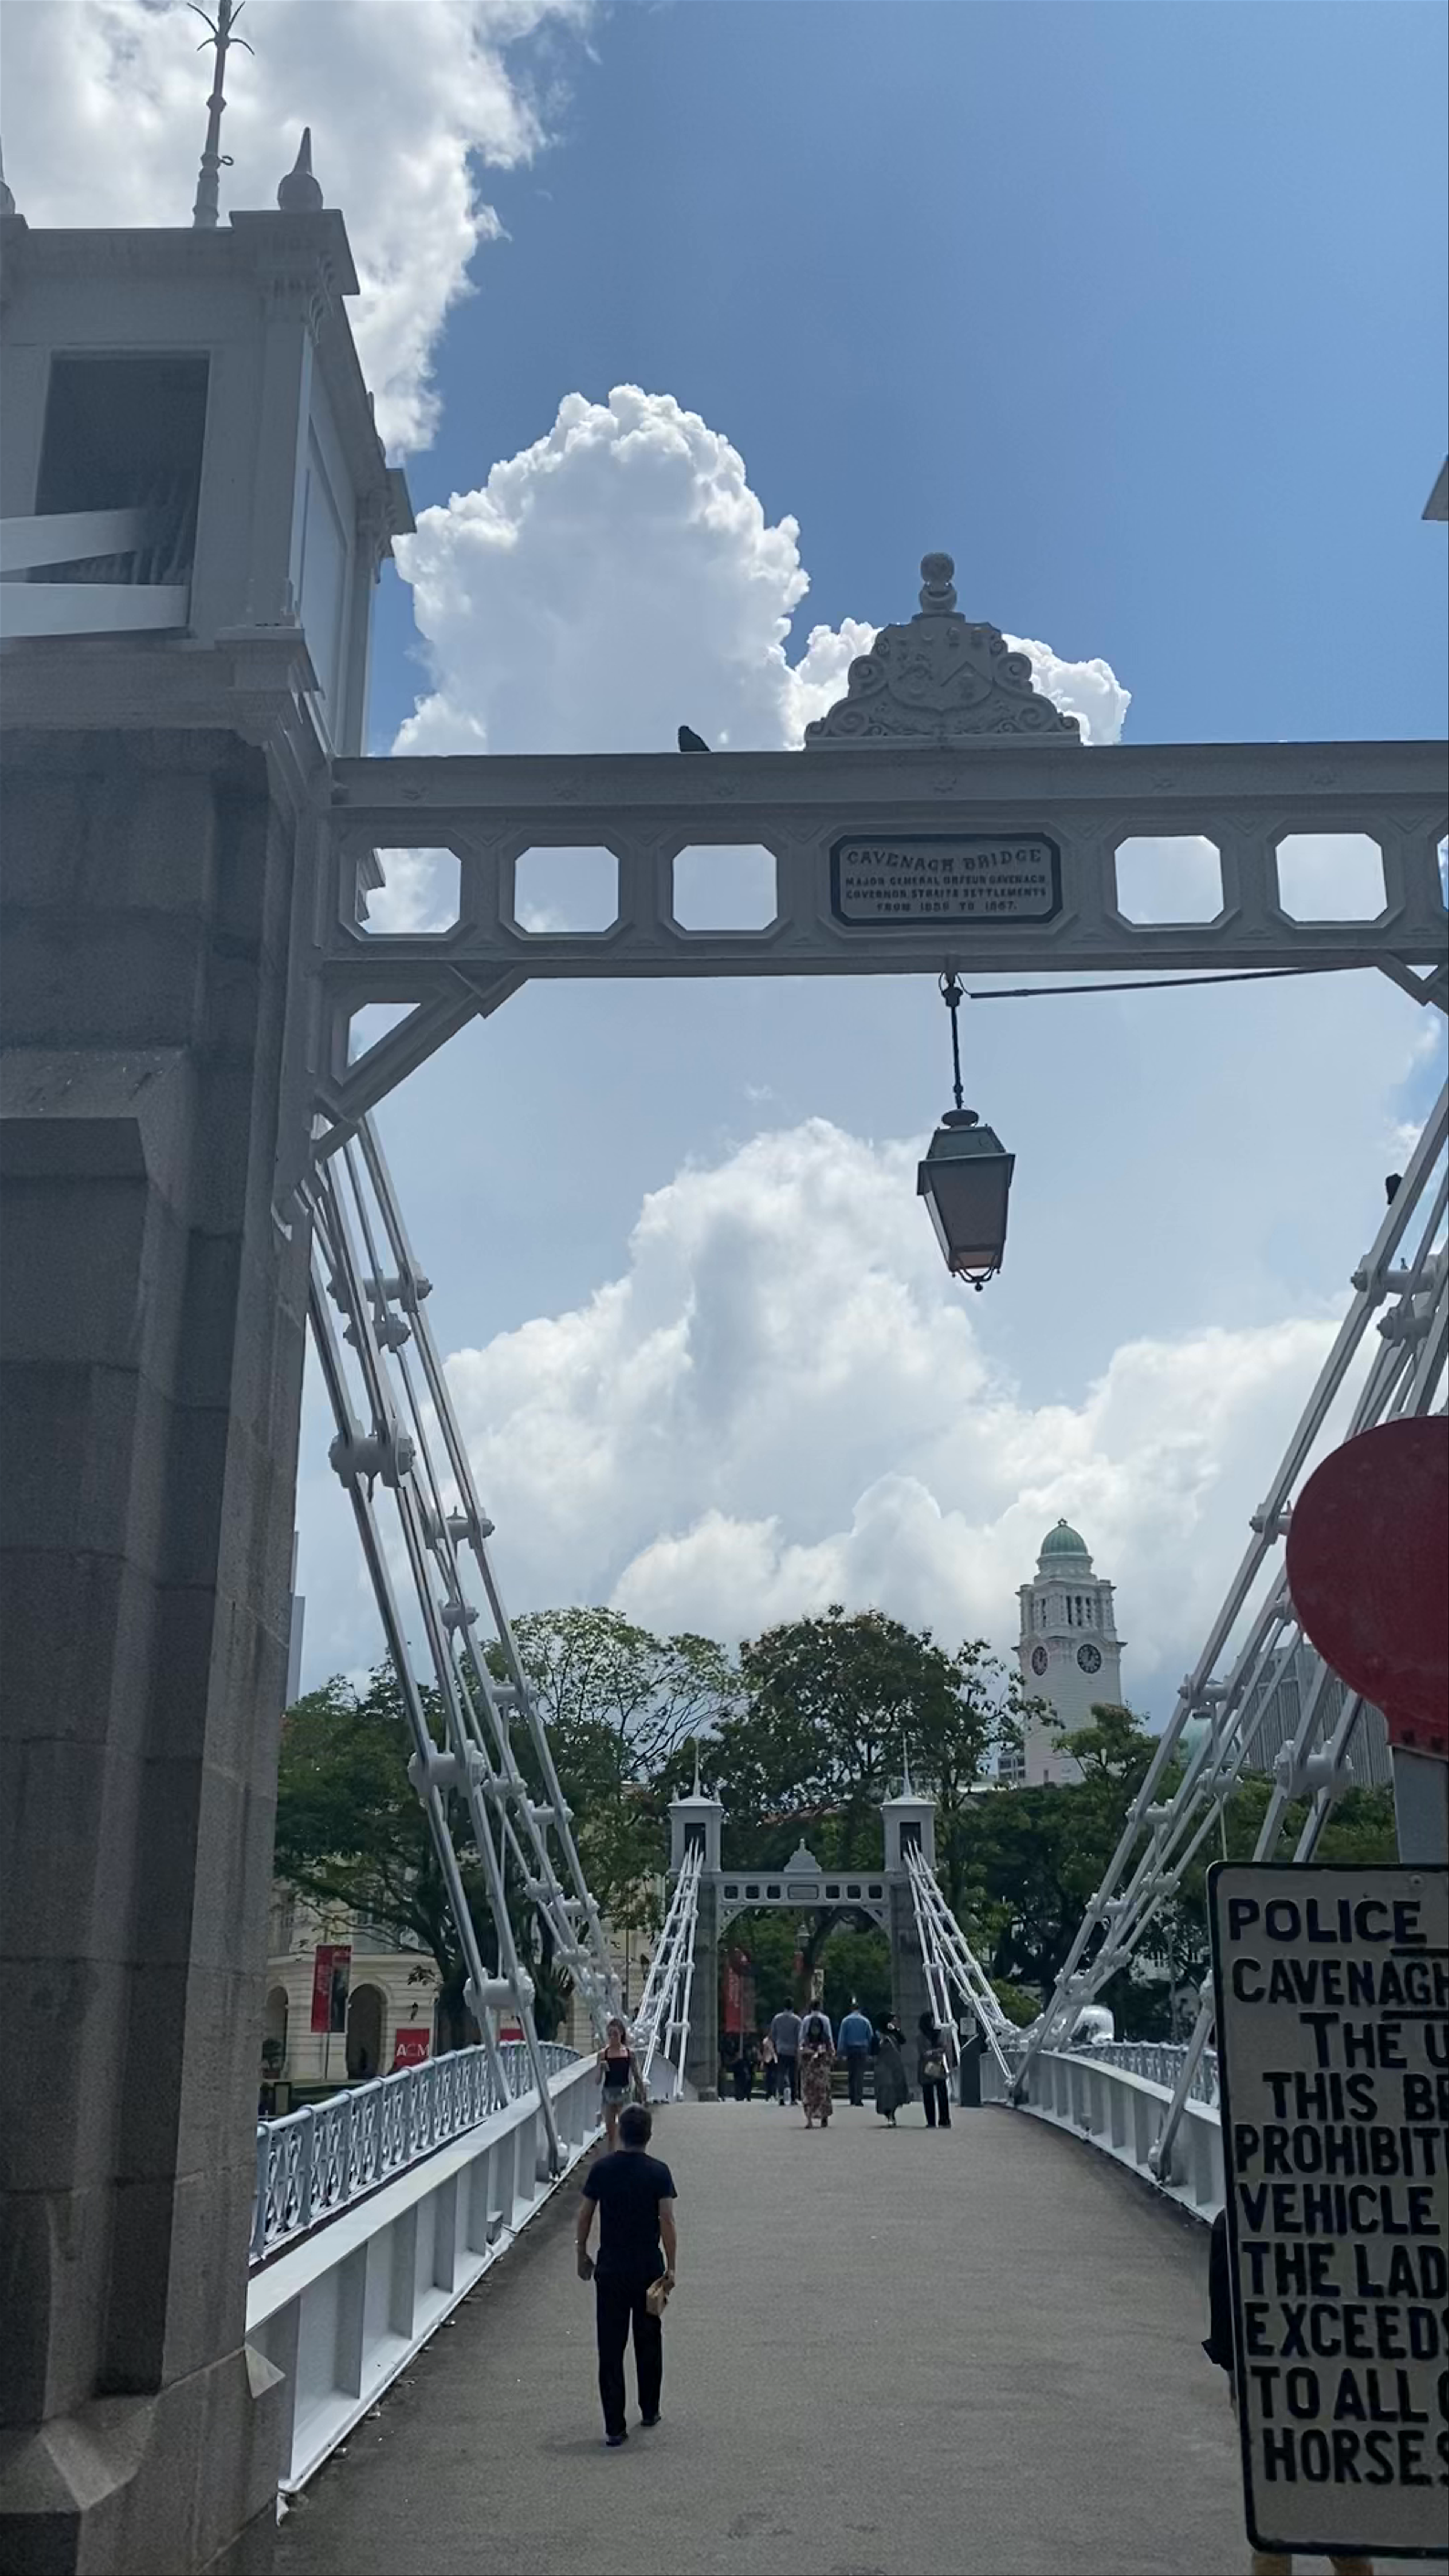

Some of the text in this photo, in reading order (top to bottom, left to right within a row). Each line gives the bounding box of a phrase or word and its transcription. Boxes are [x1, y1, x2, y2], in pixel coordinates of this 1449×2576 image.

[846, 877, 884, 886] MAJOR
[890, 876, 940, 886] GENERAL
[847, 849, 1041, 872] CAVENAGH BRIDGE
[959, 901, 974, 910] TO
[963, 887, 1046, 897] SETTLEMENTS
[1228, 1898, 1427, 1943] POLICE
[1300, 2012, 1407, 2069] THE
[1262, 2072, 1378, 2121] THIS
[1234, 2124, 1448, 2176] PROHIBIT
[1237, 2182, 1441, 2236] VEHICLE
[1241, 2241, 1341, 2297] THE
[1244, 2302, 1448, 2361] EXCEED
[1250, 2366, 1320, 2419] TO
[1334, 2367, 1429, 2423] ALL
